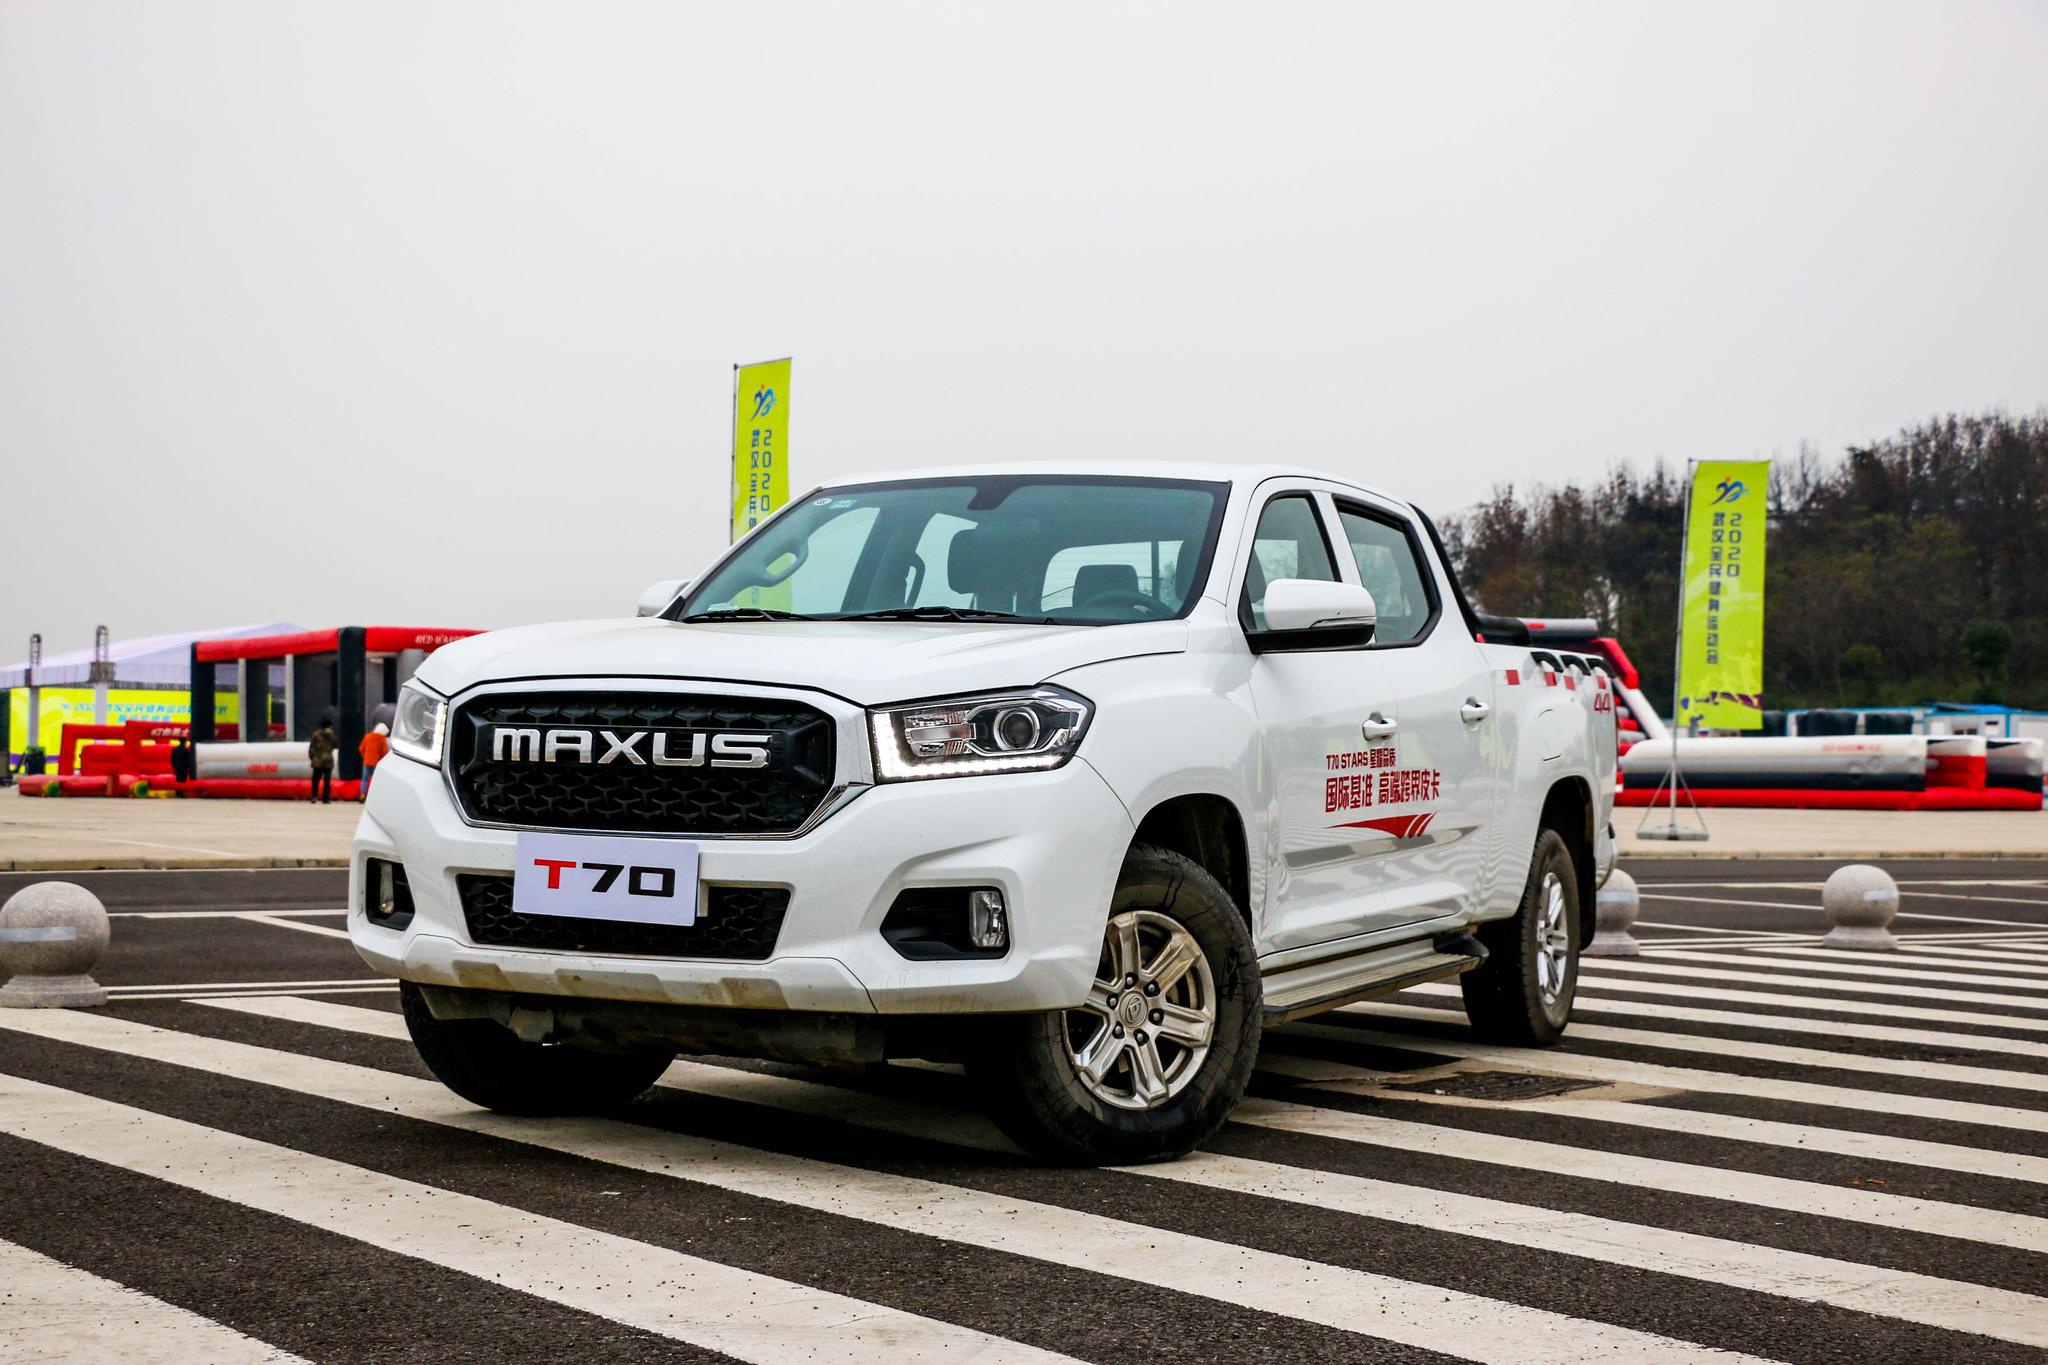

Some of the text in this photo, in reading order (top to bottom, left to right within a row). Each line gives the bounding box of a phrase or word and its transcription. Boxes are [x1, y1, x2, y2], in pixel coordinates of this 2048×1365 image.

[761, 429, 773, 511] 2020
[1727, 513, 1742, 577] 2020
[493, 727, 773, 769] MAXUS
[1326, 754, 1339, 770] T70
[1341, 751, 1369, 769] STARS
[1325, 769, 1440, 813] 国际基准 高端跨界皮卡
[534, 858, 676, 899] T70
